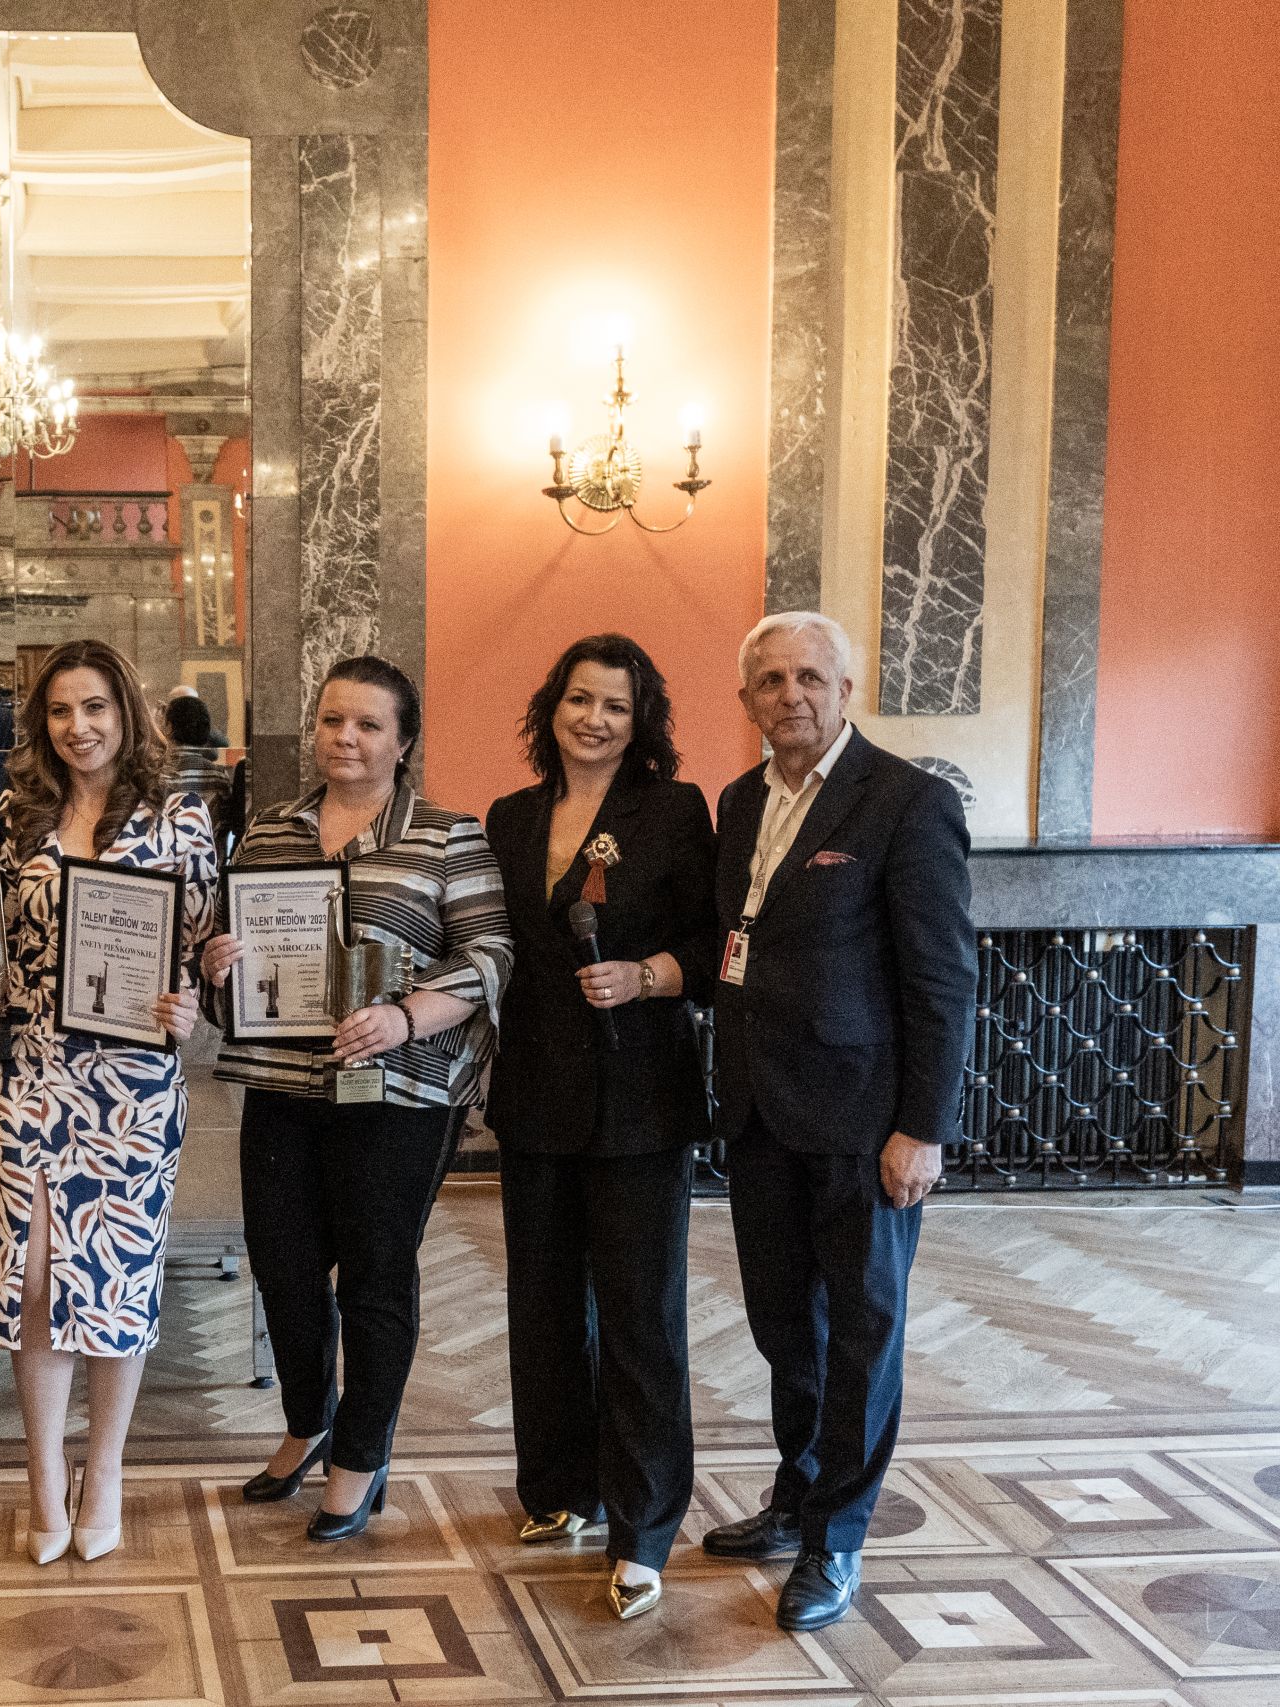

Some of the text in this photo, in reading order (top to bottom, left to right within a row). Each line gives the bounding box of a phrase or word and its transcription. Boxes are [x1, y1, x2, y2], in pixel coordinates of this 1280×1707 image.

[81, 911, 108, 924] TALENT
[109, 915, 139, 929] MEDIÓW
[245, 916, 273, 926] TALENT
[276, 913, 307, 925] MEDIÓW
[80, 940, 157, 959] ANETY PIEŃKOWSKIEJ
[252, 943, 322, 953] ANNY MROCZEK
